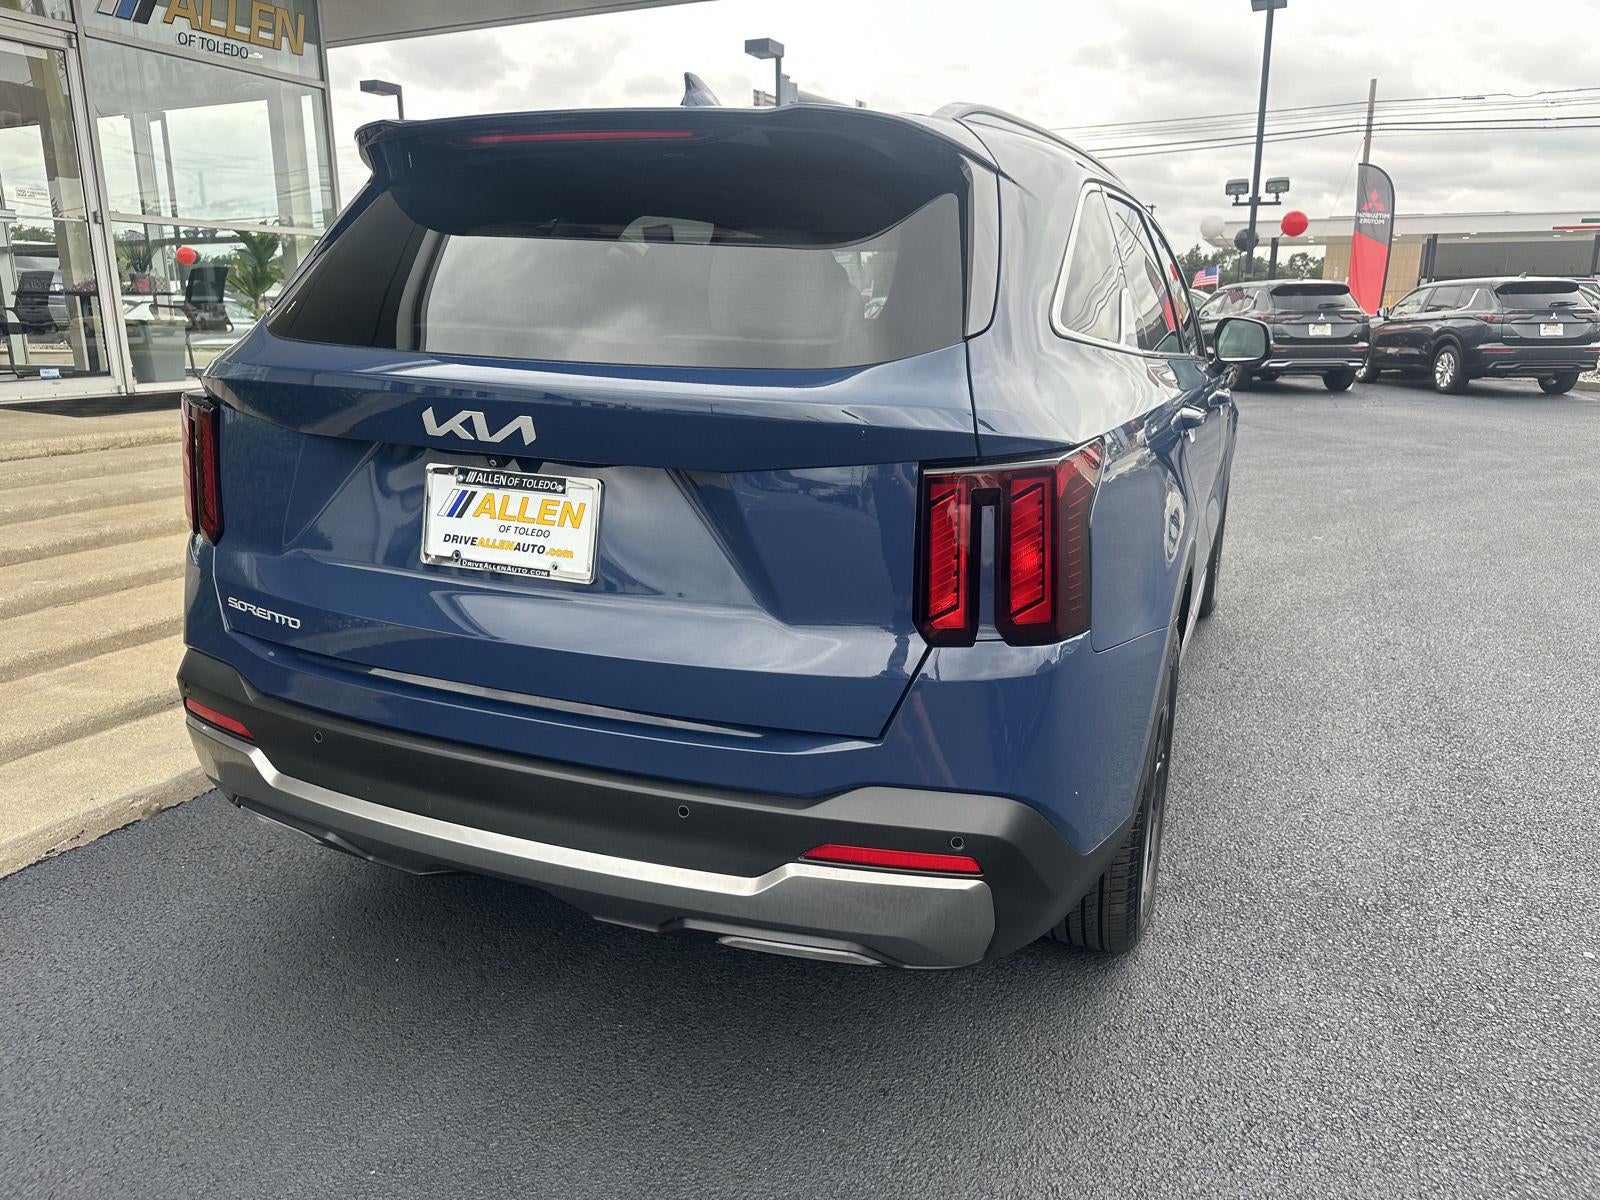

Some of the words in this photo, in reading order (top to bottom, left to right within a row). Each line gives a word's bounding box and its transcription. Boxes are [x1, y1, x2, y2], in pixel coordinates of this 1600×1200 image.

[163, 0, 305, 56] ALLEN
[177, 32, 198, 46] OF
[199, 36, 249, 59] TOLEDO
[421, 406, 537, 446] KIA
[476, 474, 507, 486] ALLEN
[507, 477, 520, 488] OF
[522, 478, 557, 491] TOLEDO
[472, 492, 587, 529] ALLEN
[498, 524, 512, 534] OF
[514, 526, 551, 538] TOLEDO
[227, 596, 301, 630] SORENTO
